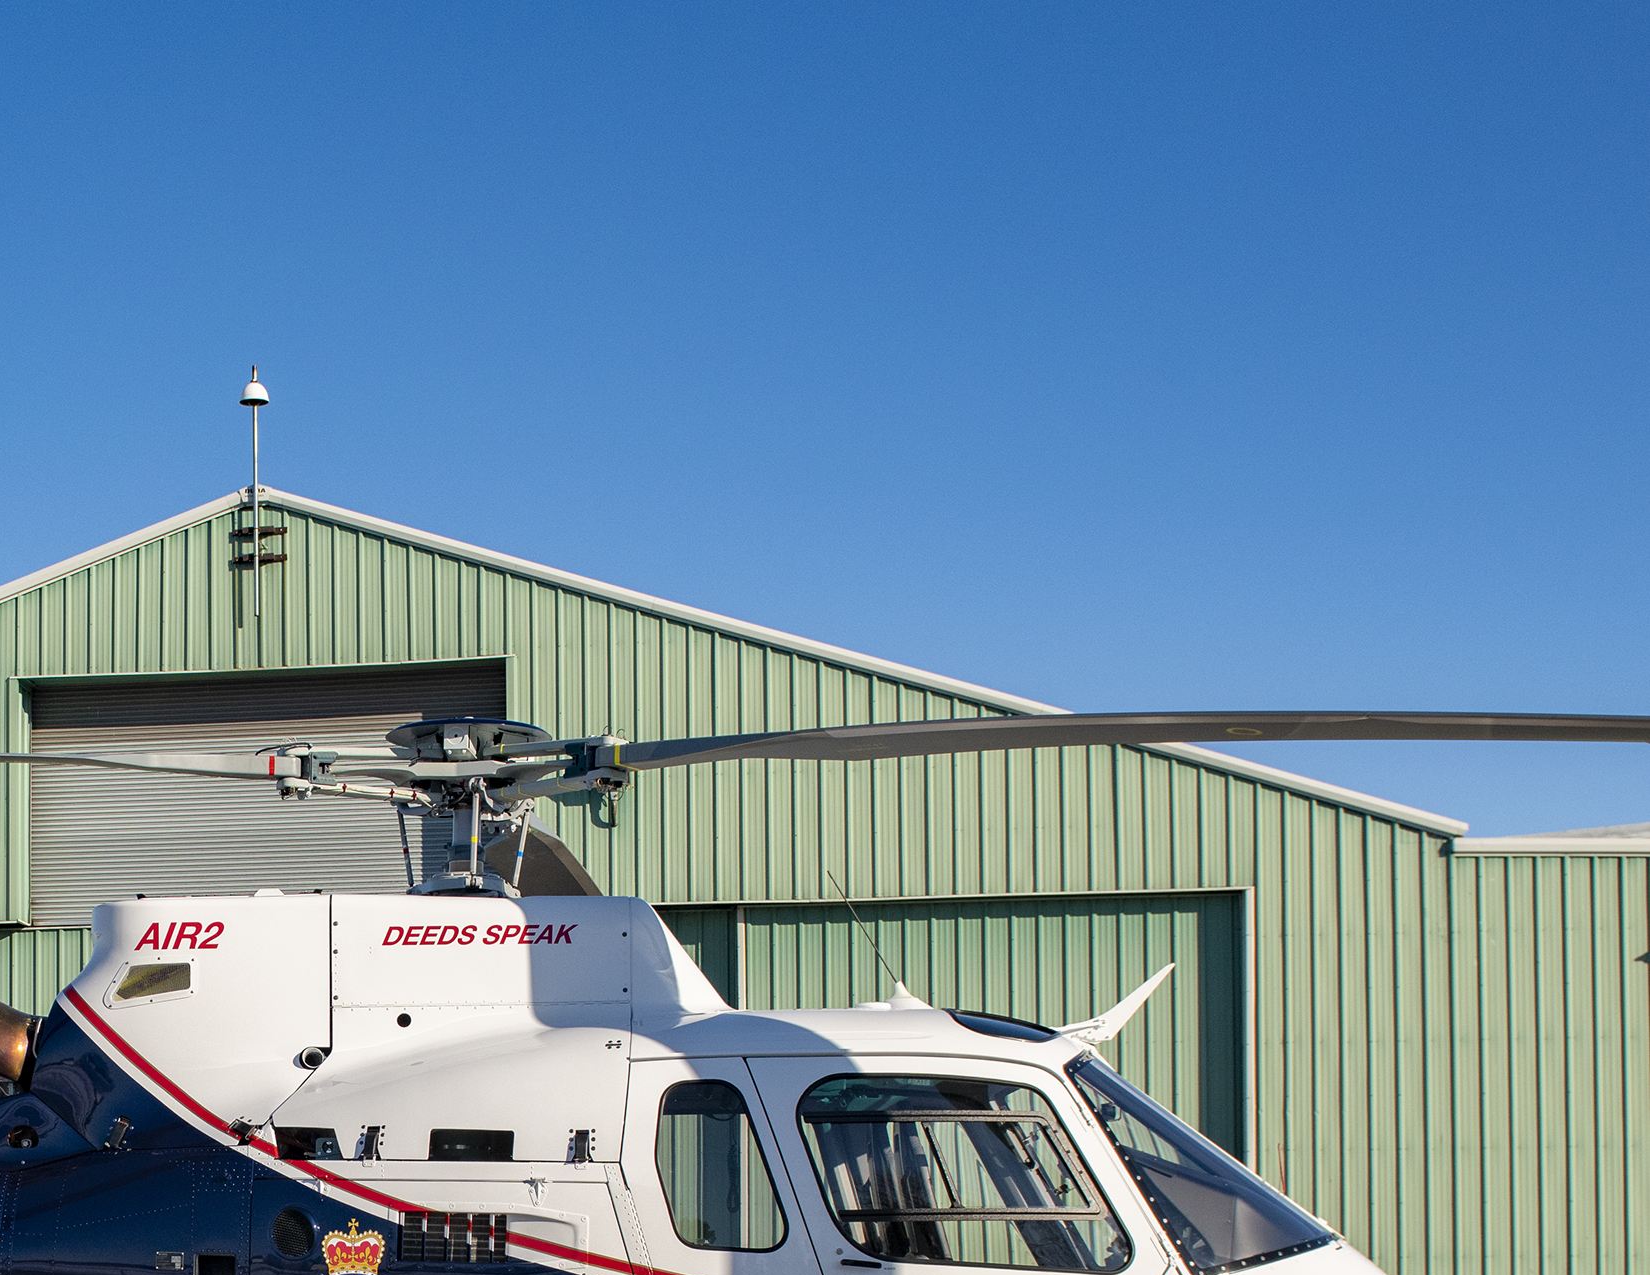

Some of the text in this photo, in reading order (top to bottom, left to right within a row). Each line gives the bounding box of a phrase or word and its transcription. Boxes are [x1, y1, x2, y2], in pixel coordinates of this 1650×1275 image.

[134, 921, 225, 951] AIR2
[382, 924, 578, 946] DEEDS SPEAK
